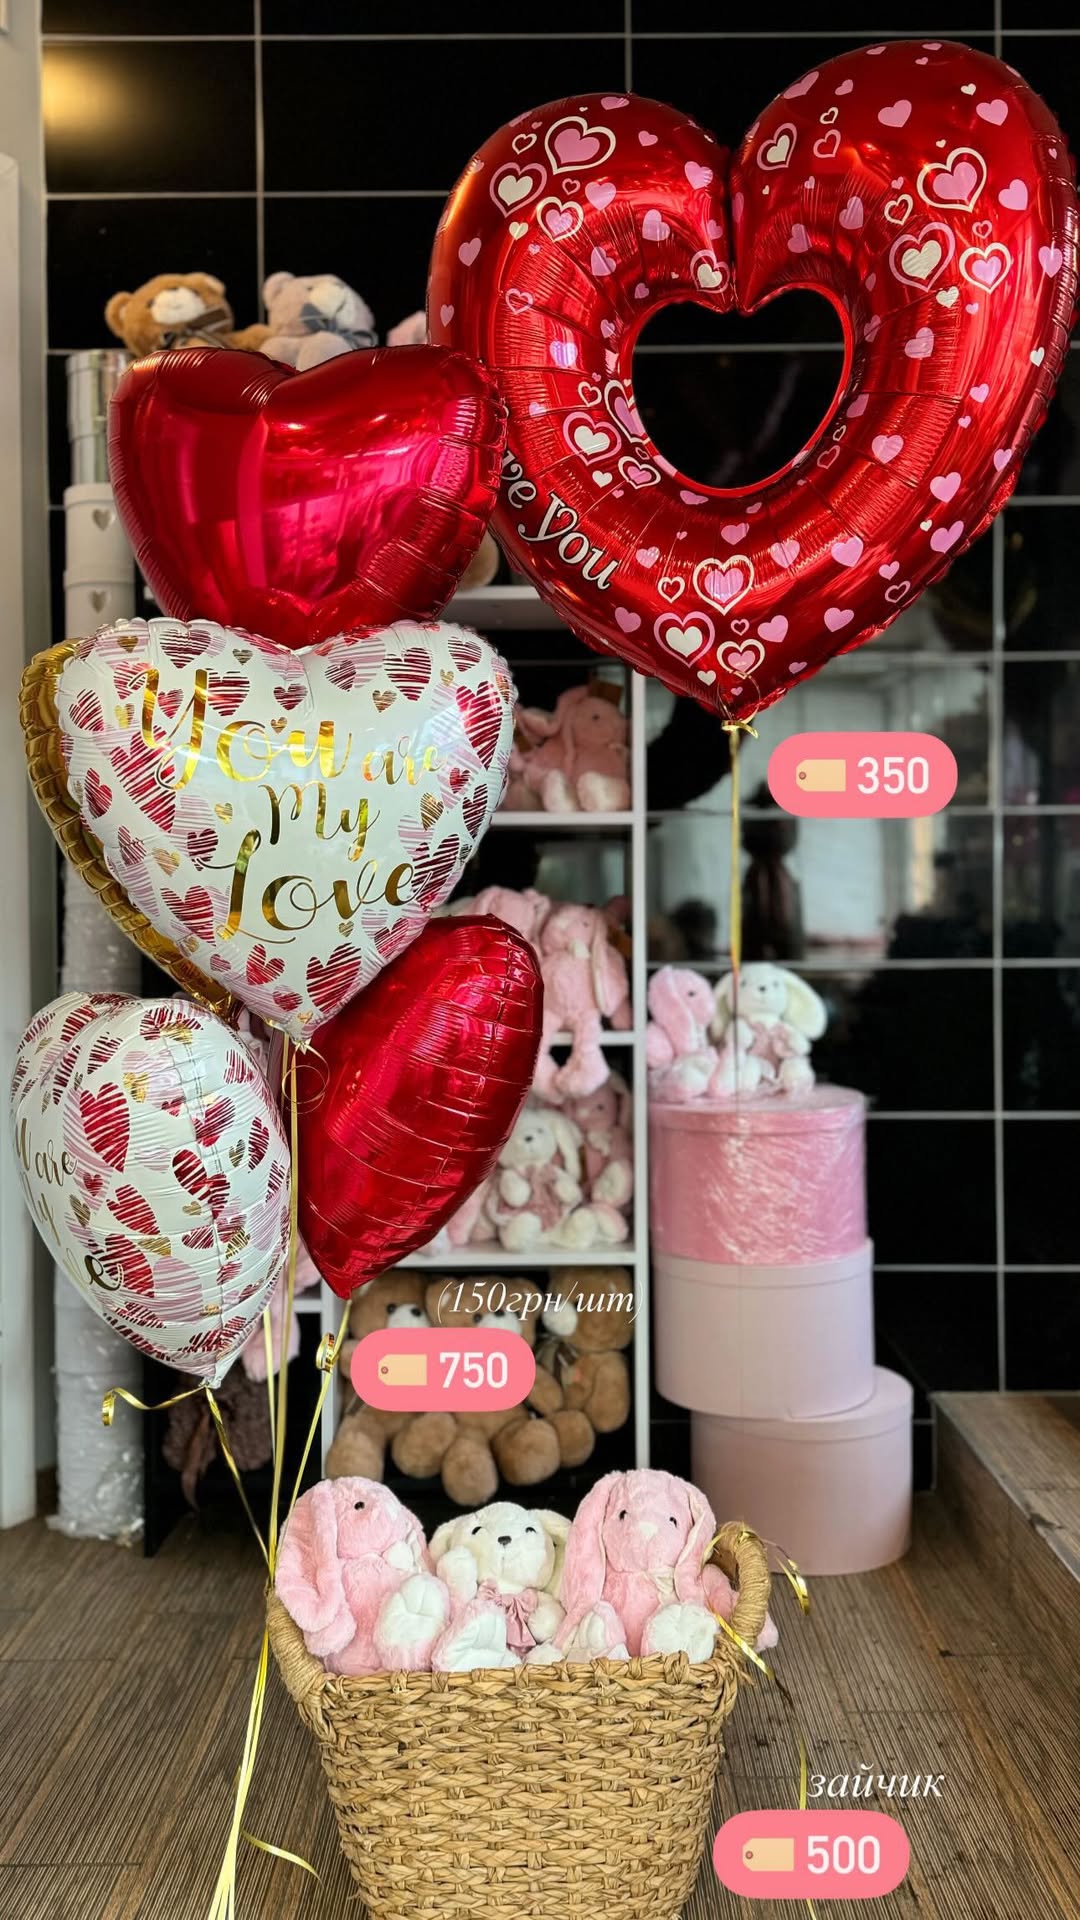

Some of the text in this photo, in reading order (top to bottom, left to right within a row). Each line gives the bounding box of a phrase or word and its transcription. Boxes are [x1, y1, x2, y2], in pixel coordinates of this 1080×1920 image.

[501, 450, 619, 590] ve you
[129, 668, 447, 790] You are
[257, 781, 380, 861] My
[197, 829, 433, 944] Love
[35, 1139, 78, 1187] are
